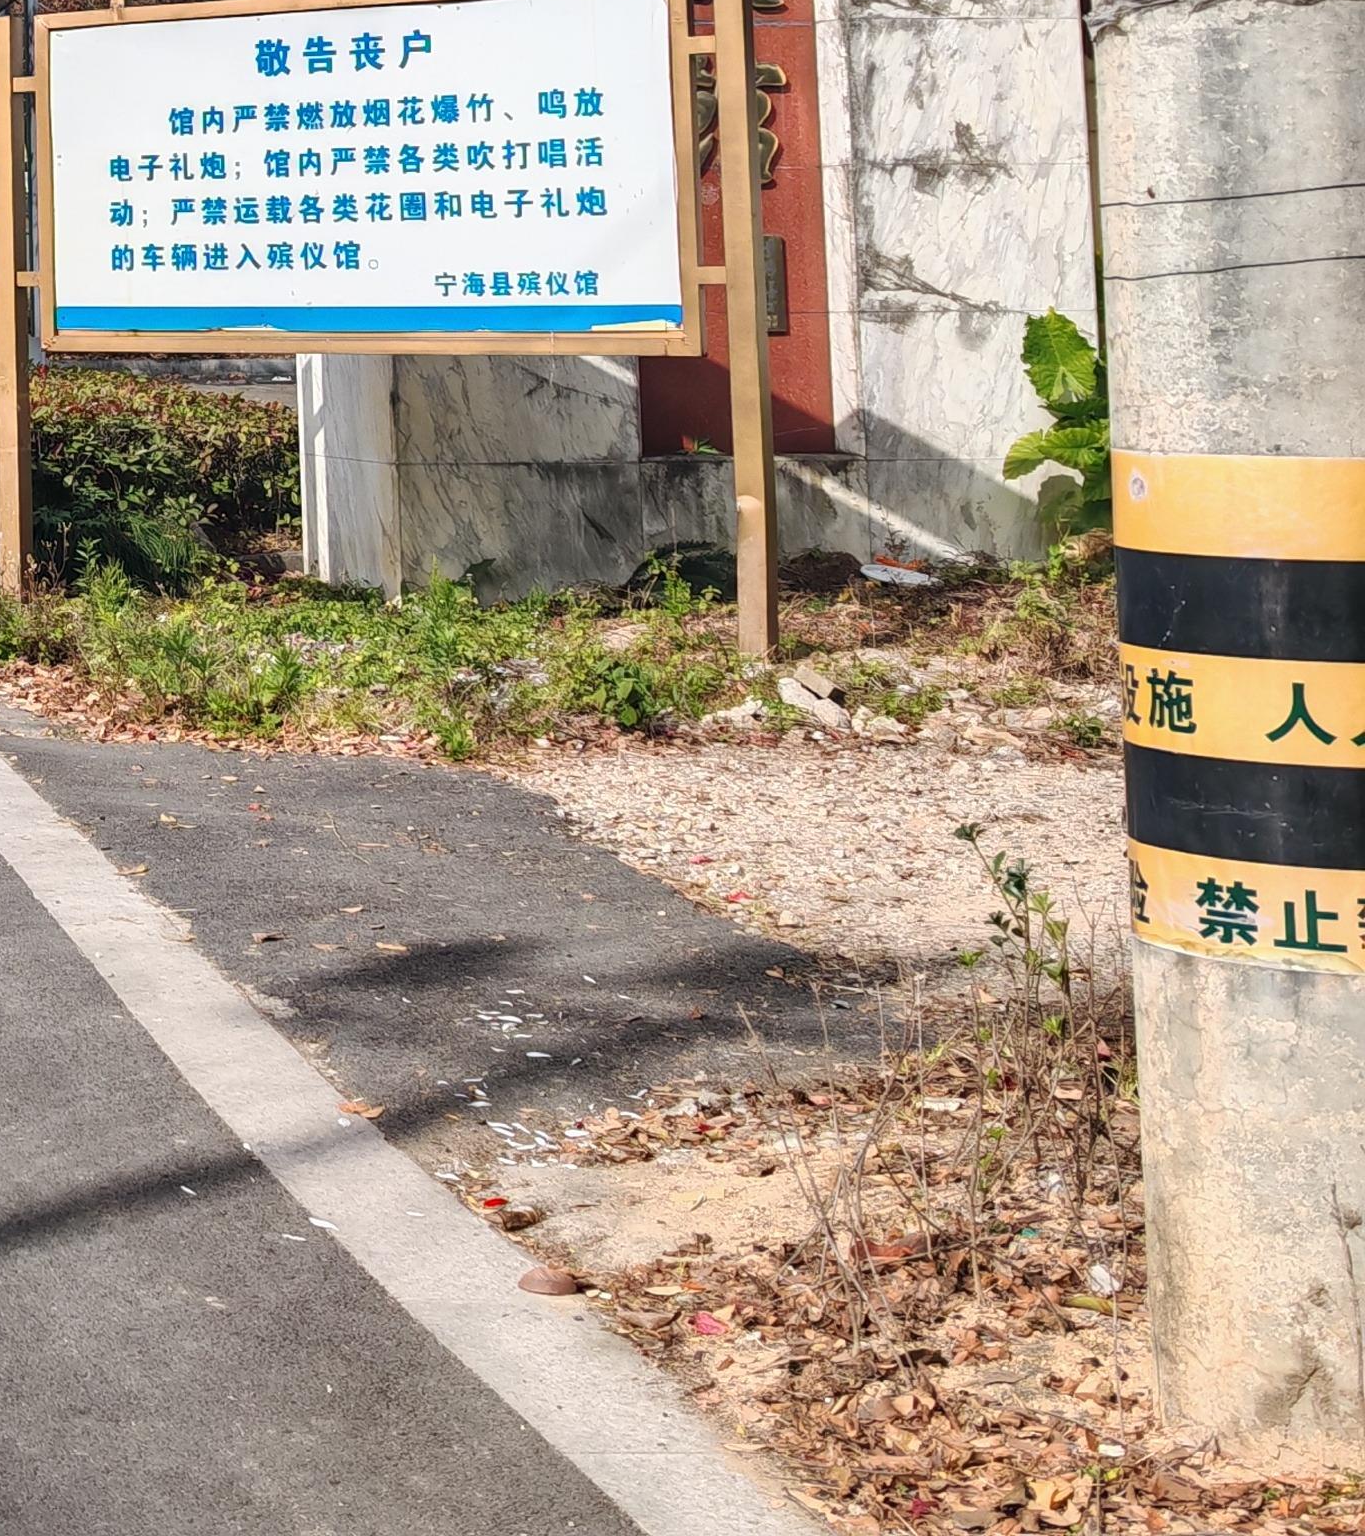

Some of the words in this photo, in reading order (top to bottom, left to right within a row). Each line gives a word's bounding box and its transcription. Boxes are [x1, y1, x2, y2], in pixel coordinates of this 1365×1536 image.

[254, 30, 433, 78] 敬告丧户
[168, 87, 604, 137] 馆内严禁燃放烟花爆竹、鸣放
[108, 137, 604, 183] 电子礼炮；馆内严禁各类吹打唱活
[108, 186, 608, 228] 动；严禁运载各类花圈和电子礼炮
[110, 240, 380, 272] 的车辆进入殡仪馆。
[434, 270, 600, 298] 宁海县殡仪馆
[1264, 681, 1365, 748] 人
[1195, 875, 1365, 955] 禁止
